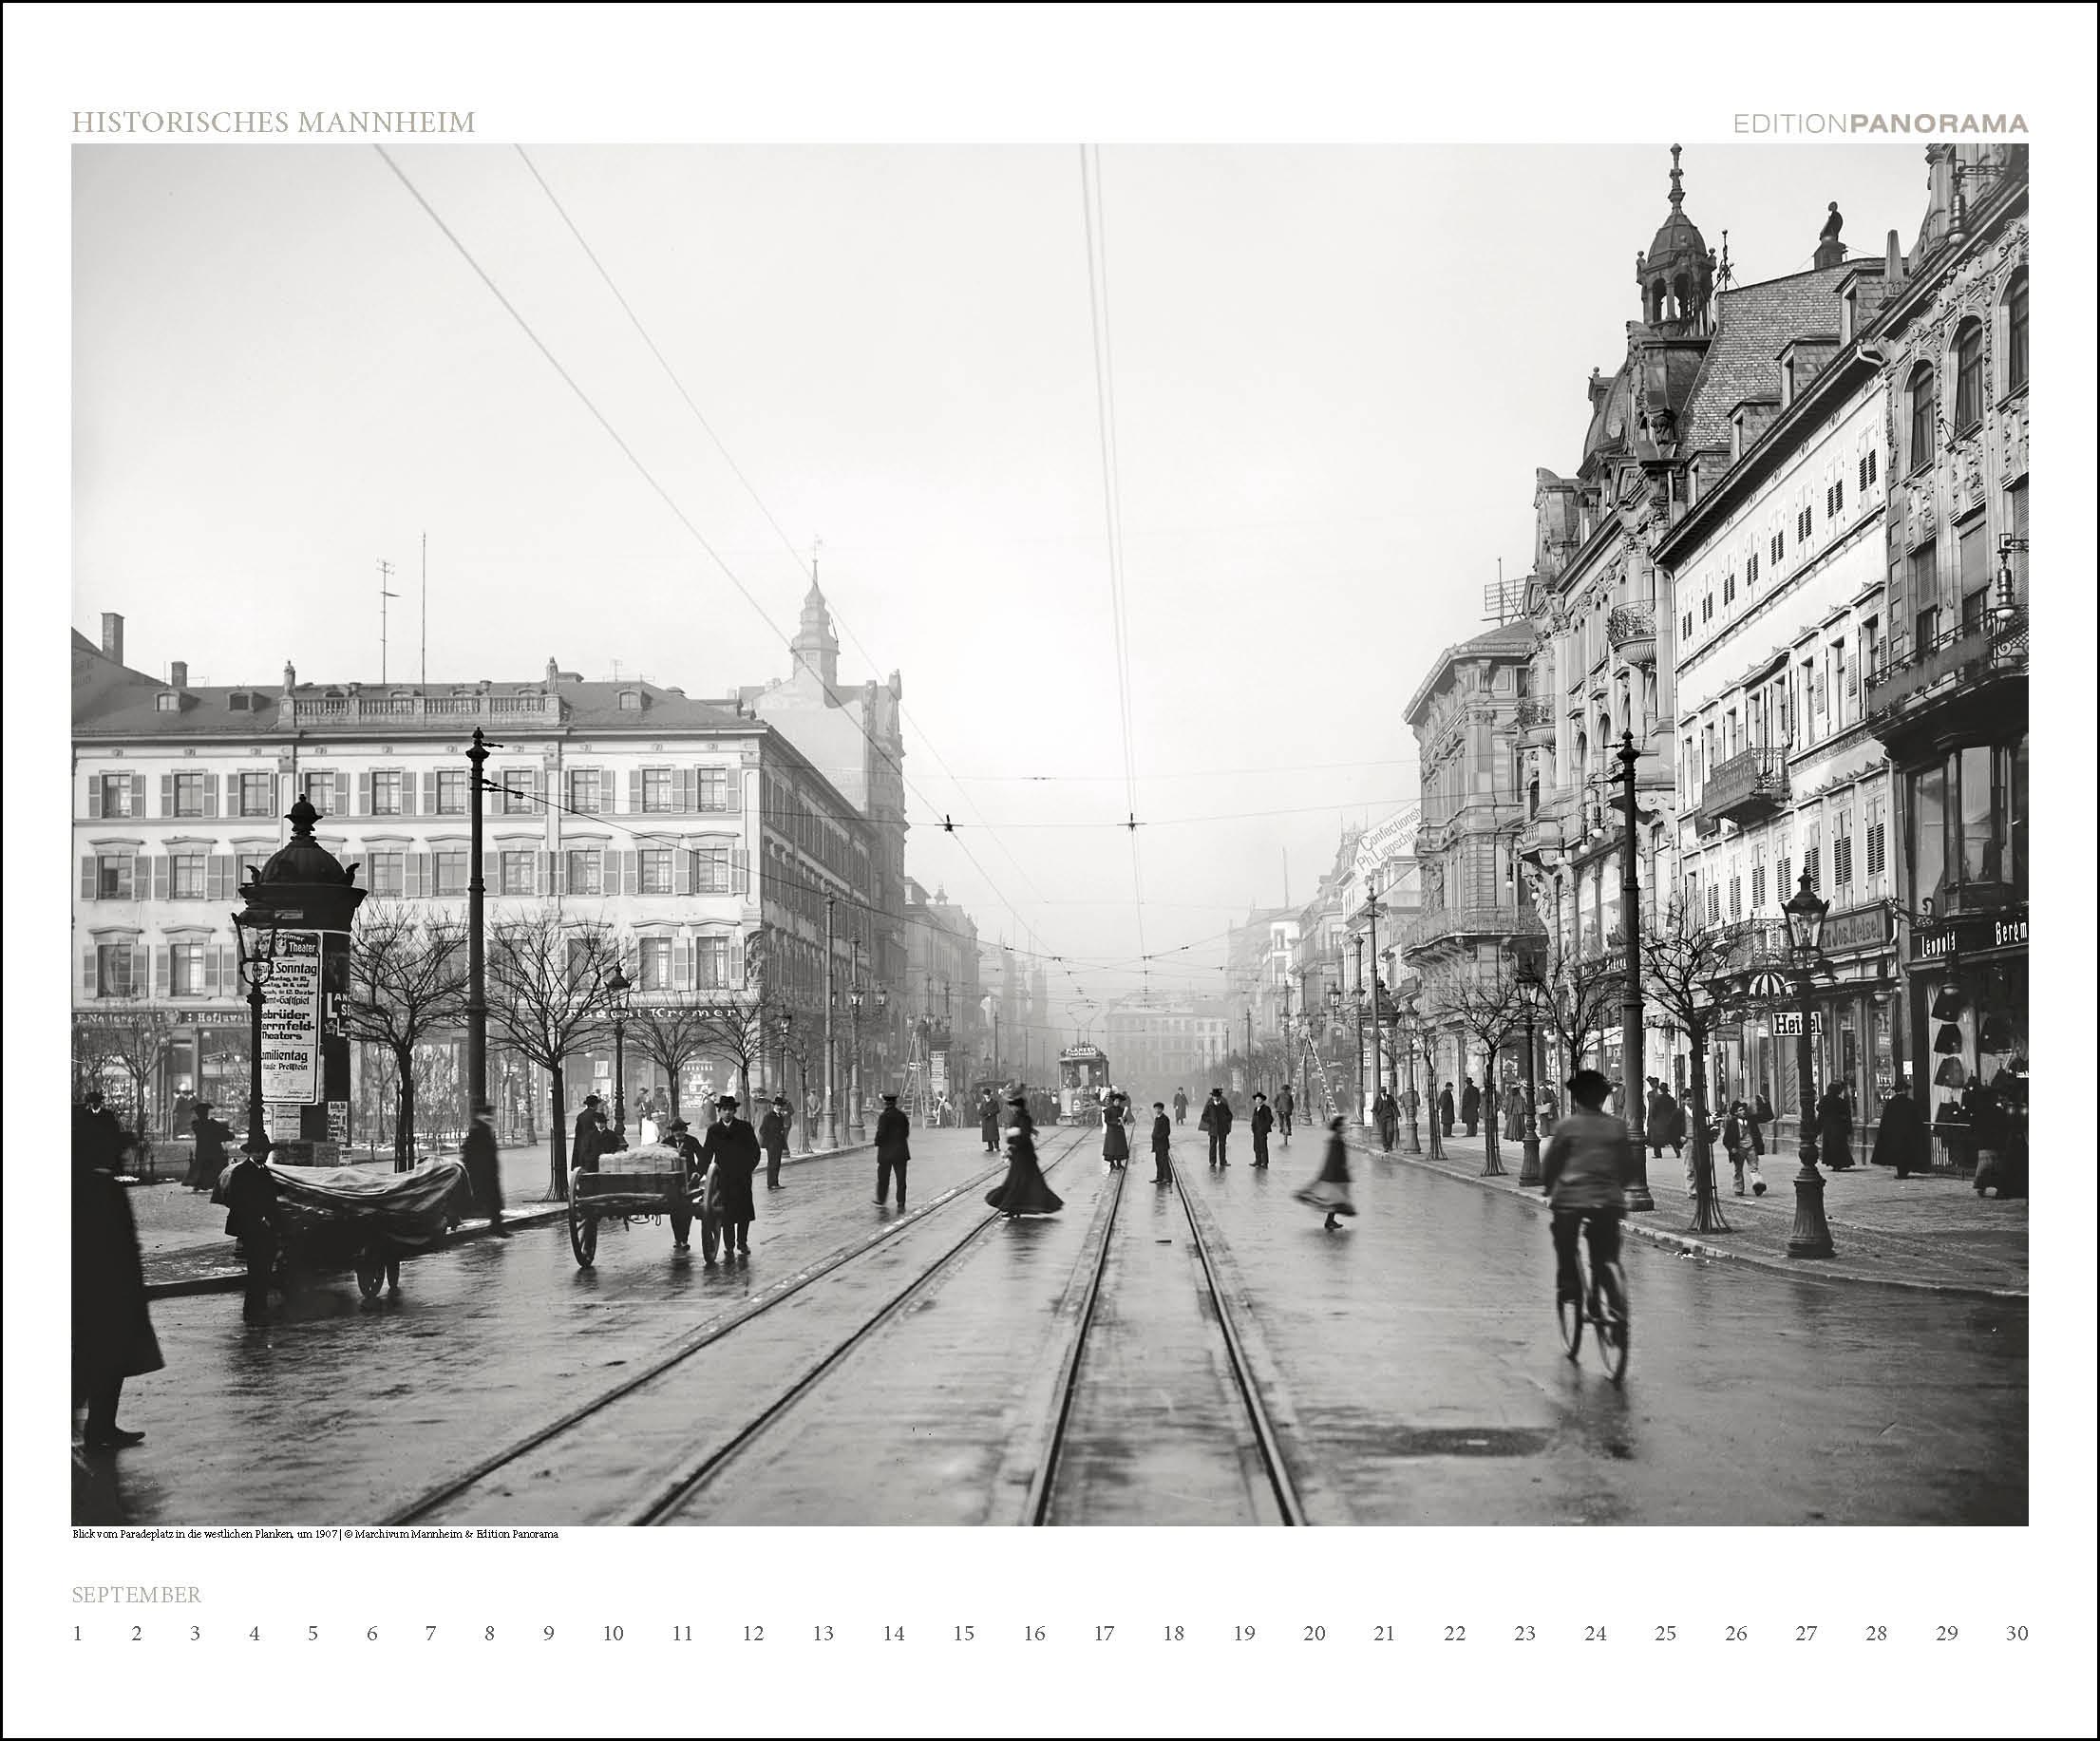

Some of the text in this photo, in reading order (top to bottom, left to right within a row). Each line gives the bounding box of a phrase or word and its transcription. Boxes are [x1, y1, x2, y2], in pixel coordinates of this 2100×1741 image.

[289, 941, 317, 953] Theater
[275, 962, 318, 977] Sonntag
[1774, 1012, 1821, 1034] Heiel
